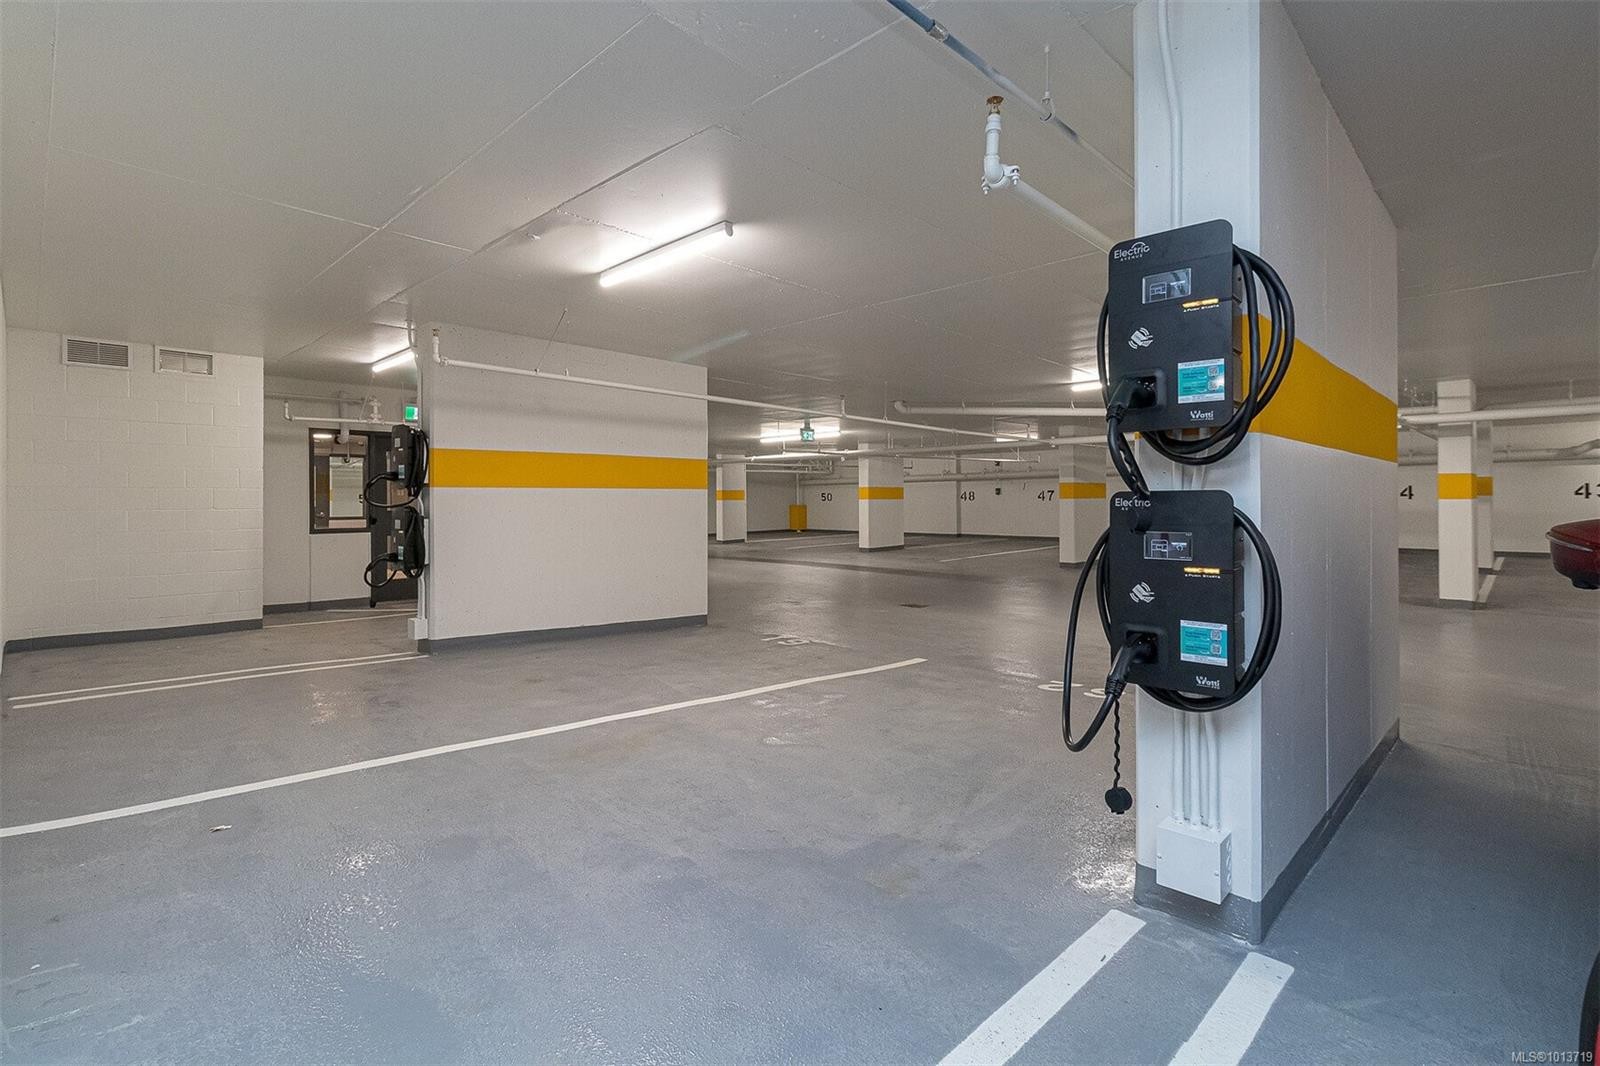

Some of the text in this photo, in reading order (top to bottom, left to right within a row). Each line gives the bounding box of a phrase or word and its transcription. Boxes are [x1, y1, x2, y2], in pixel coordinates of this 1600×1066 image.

[1114, 243, 1150, 259] Electric
[820, 492, 833, 502] 50
[960, 491, 976, 501] 48
[1037, 490, 1055, 501] 47
[1114, 497, 1151, 507] Electric
